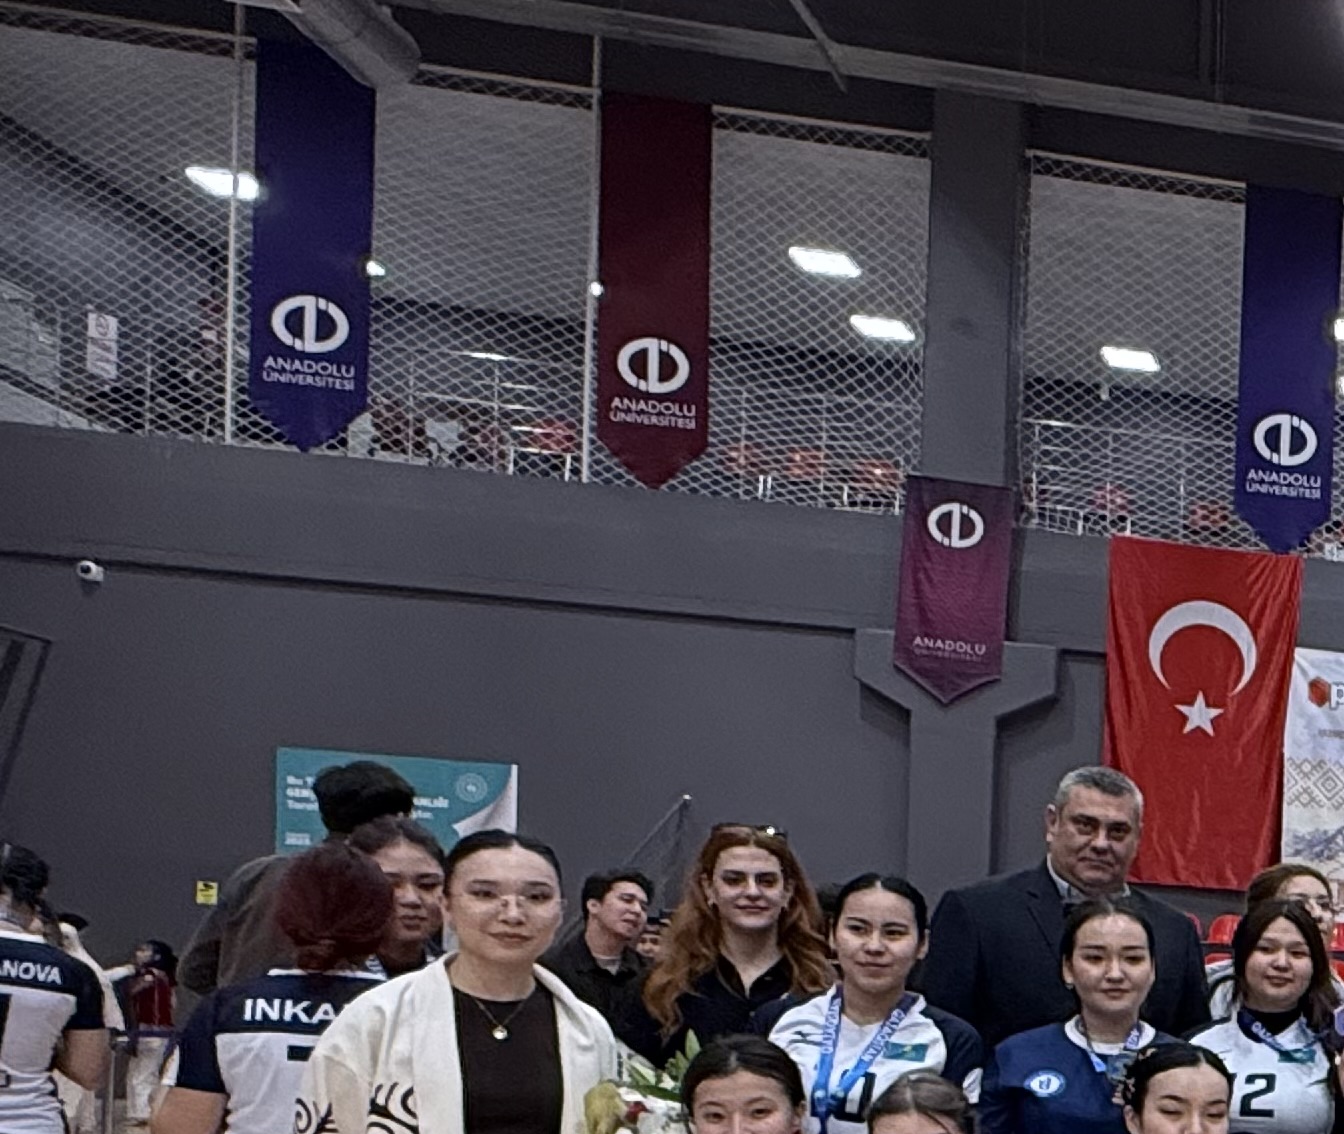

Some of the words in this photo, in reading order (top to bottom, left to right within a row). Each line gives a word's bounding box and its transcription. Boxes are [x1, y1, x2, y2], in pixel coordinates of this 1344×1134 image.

[263, 355, 355, 378] ANADOLU
[610, 396, 696, 417] ANADOLU
[1246, 468, 1322, 488] ANADOLU
[912, 635, 987, 656] ANADOLU
[0, 959, 62, 986] NOVA
[244, 998, 348, 1024] INKA
